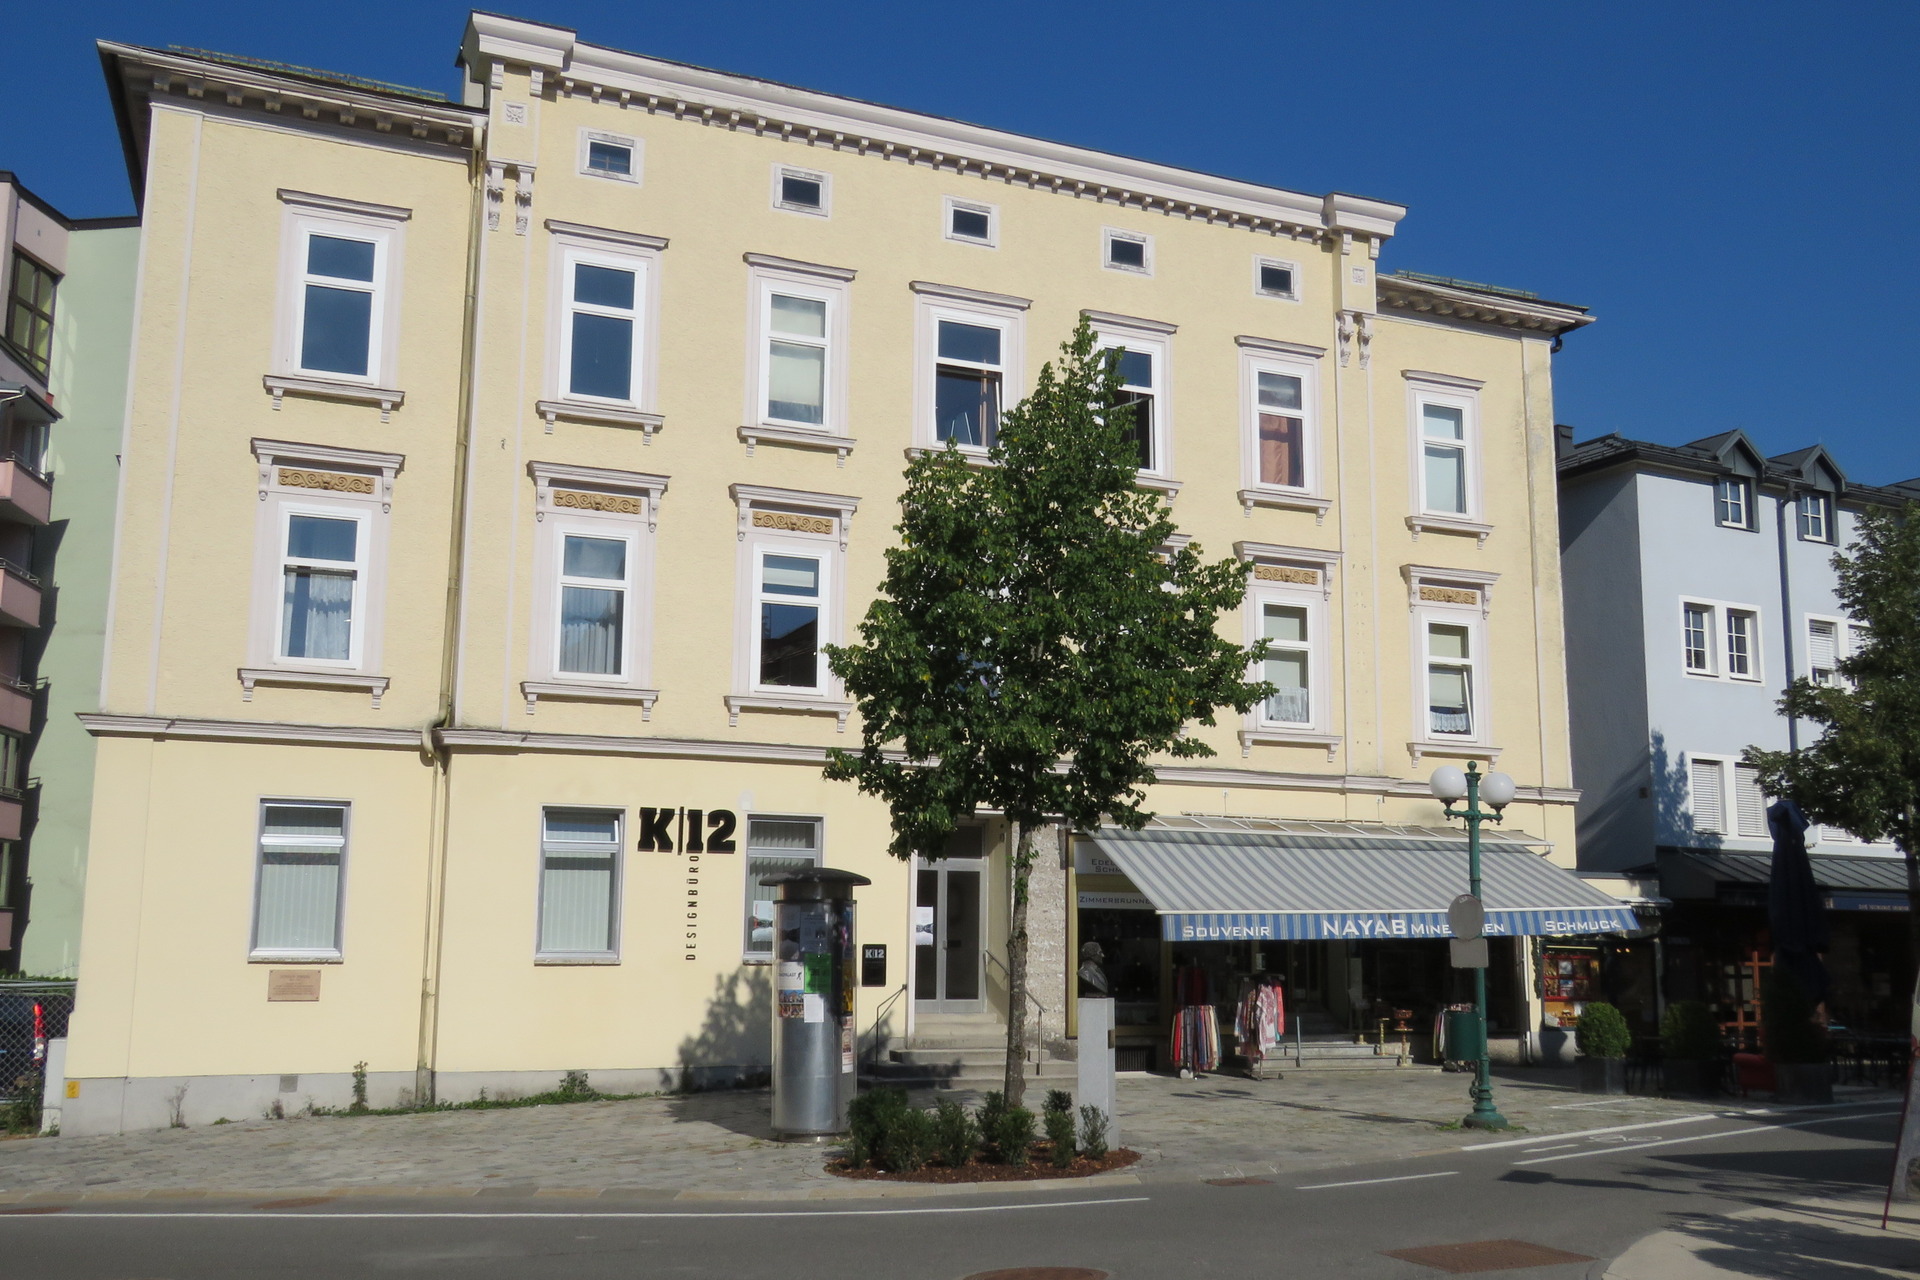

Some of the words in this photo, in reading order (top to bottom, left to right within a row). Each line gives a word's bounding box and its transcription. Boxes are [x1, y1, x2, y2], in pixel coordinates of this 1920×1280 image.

[685, 855, 700, 961] DESIGNBÜRO
[1182, 925, 1271, 938] SOUVENIR
[1322, 919, 1407, 937] NAYAB
[1545, 919, 1621, 932] SCHMUCK
